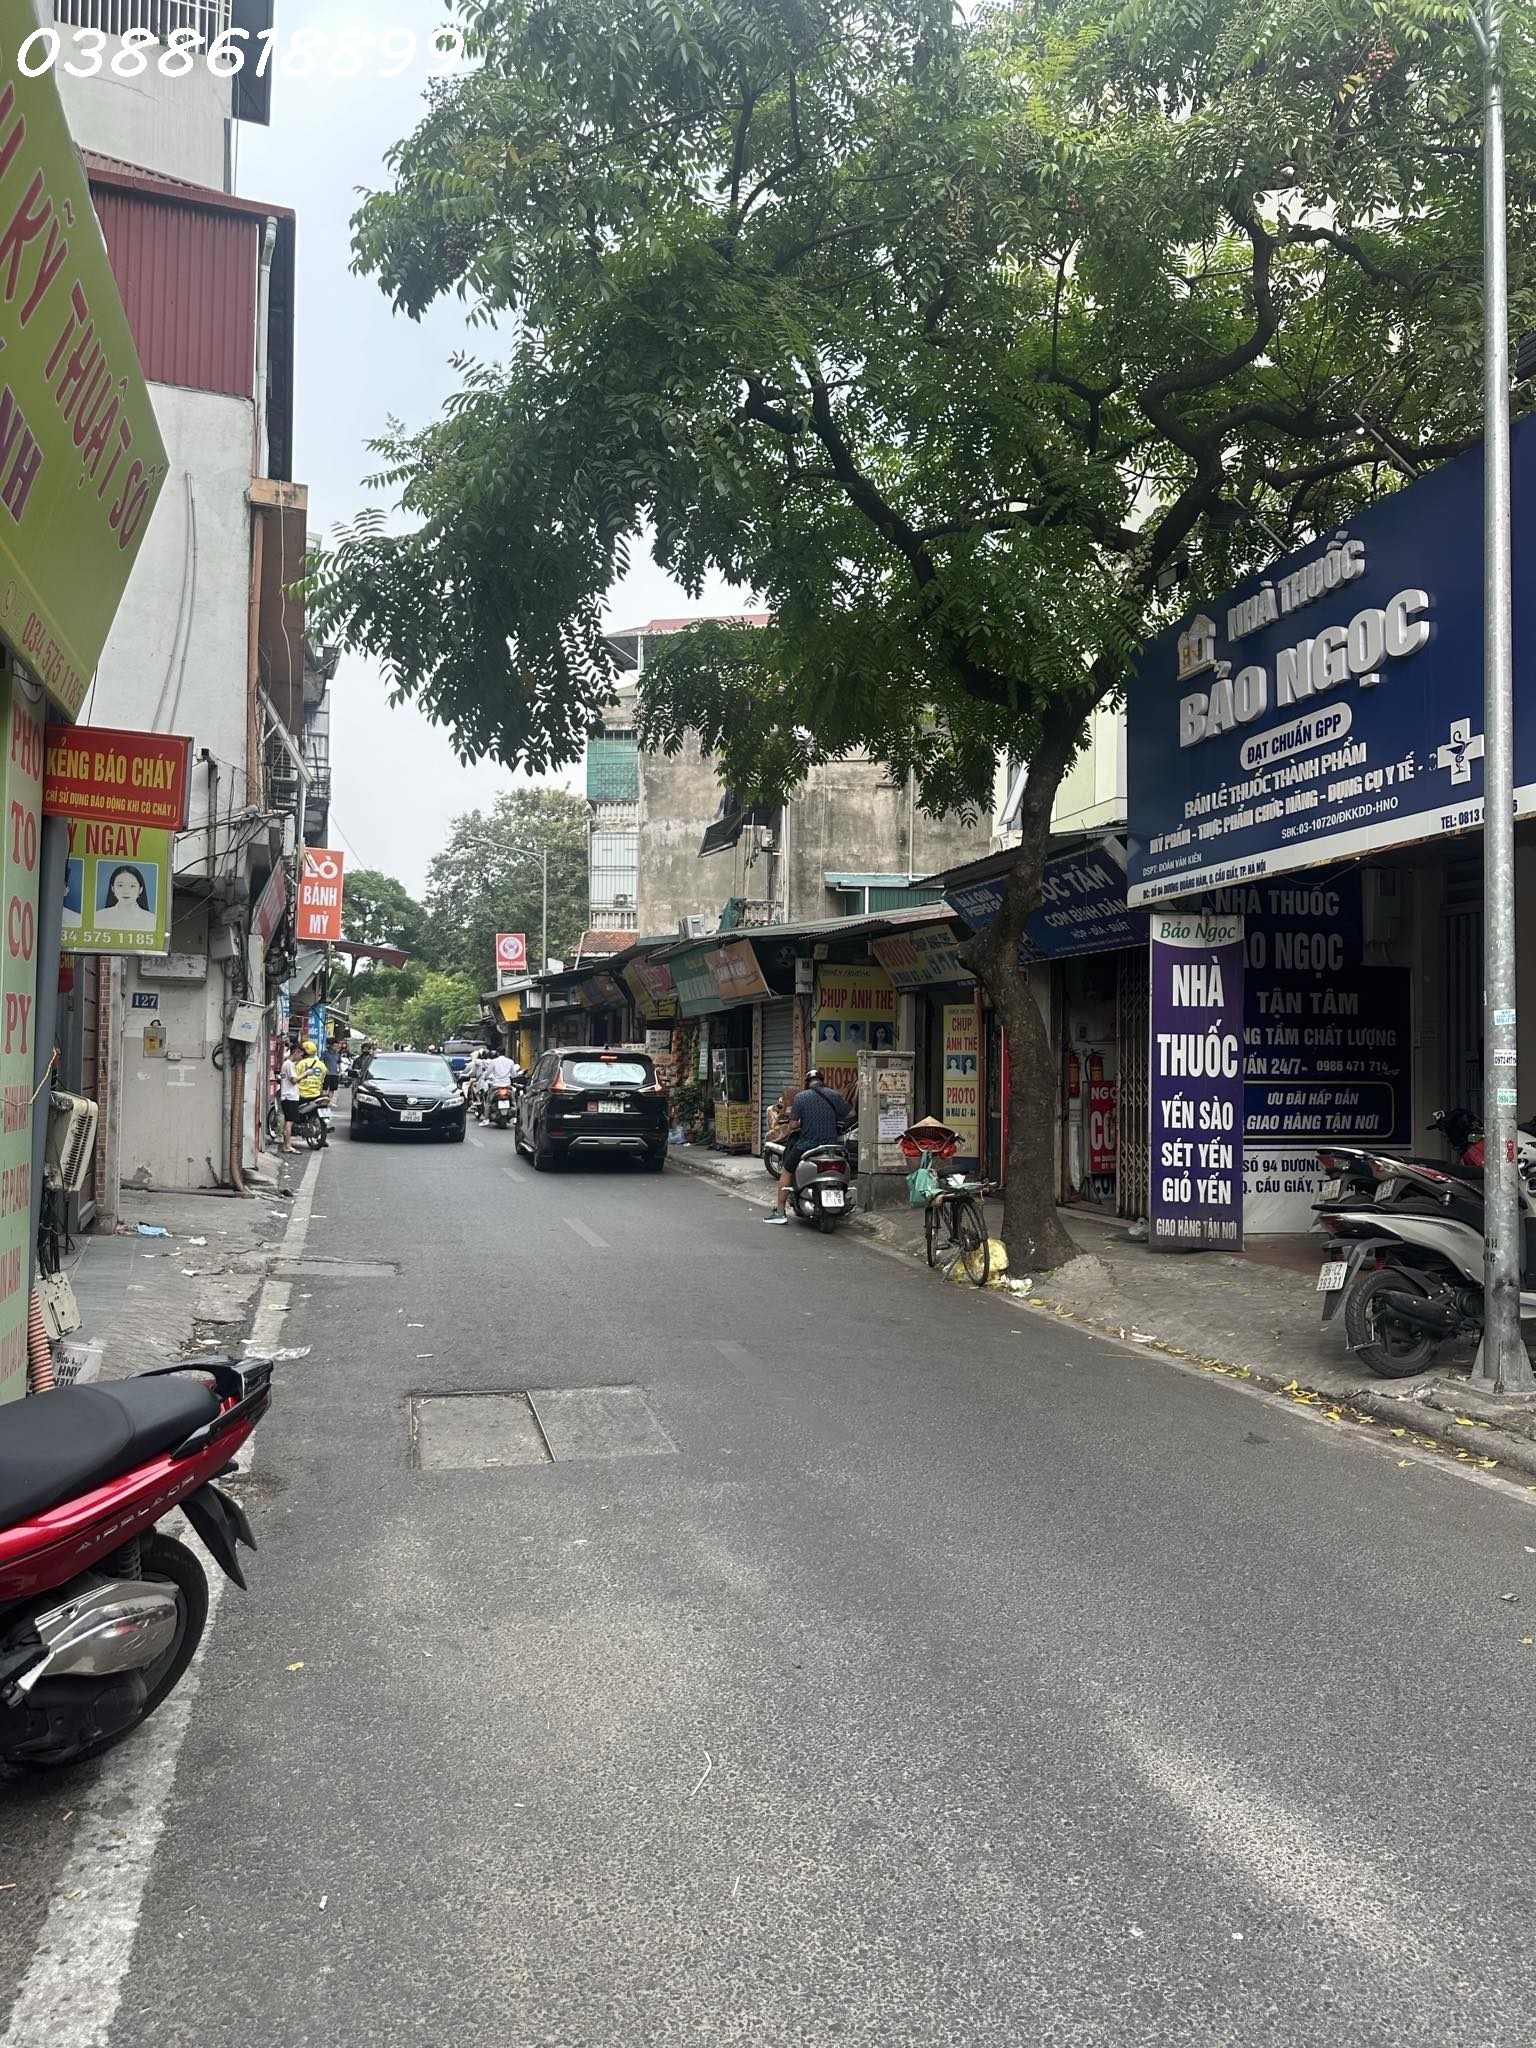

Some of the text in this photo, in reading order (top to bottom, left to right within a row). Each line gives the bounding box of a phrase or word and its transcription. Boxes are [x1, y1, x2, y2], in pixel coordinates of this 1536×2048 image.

[45, 278, 133, 501] THUẬT
[109, 459, 164, 550] SỐ
[1228, 531, 1365, 642] NHÀ THUỐC
[1179, 589, 1430, 748] BẢO NGỌC
[11, 703, 42, 782] PHO
[1248, 713, 1341, 764] ĐẠT CHUẨN GPP
[47, 736, 176, 790] KẺNG BÁO CHÁY
[1185, 792, 1211, 819] BÁN
[1228, 768, 1271, 804] THUỐC
[1271, 759, 1319, 790] THÀNH
[1321, 736, 1367, 775] PHẨM
[1385, 766, 1395, 785] Y
[11, 799, 37, 872] TO
[1441, 814, 1457, 829] TEL:
[1458, 808, 1480, 826] 0813
[85, 824, 142, 857] NGAY
[303, 882, 338, 907] BÁNH
[1062, 864, 1115, 893] TÂM
[8, 896, 34, 961] CO
[83, 931, 111, 943] 575
[119, 932, 154, 945] 1185
[1160, 920, 1236, 943] Bảo Ngọc
[1275, 932, 1343, 979] NGỌC
[1172, 955, 1225, 1007] NHÀ
[134, 994, 157, 1008] 127
[1257, 987, 1302, 1019] TẬN
[5, 992, 32, 1054] PY
[1157, 1018, 1238, 1078] THUỐC
[946, 1087, 976, 1104] PHOTO
[1161, 1091, 1234, 1131] YẾN SÀO
[1246, 1114, 1280, 1130] GIAO
[1282, 1112, 1321, 1130] HÀNG
[1161, 1136, 1233, 1169] SÉT YẾN
[1263, 1160, 1278, 1172] 94
[1162, 1170, 1231, 1205] GIỎ YẾN
[1256, 1176, 1280, 1193] CẦU
[1156, 1218, 1175, 1236] GIAO
[1178, 1216, 1200, 1238] HÀNG
[1203, 1217, 1220, 1242] TẬN
